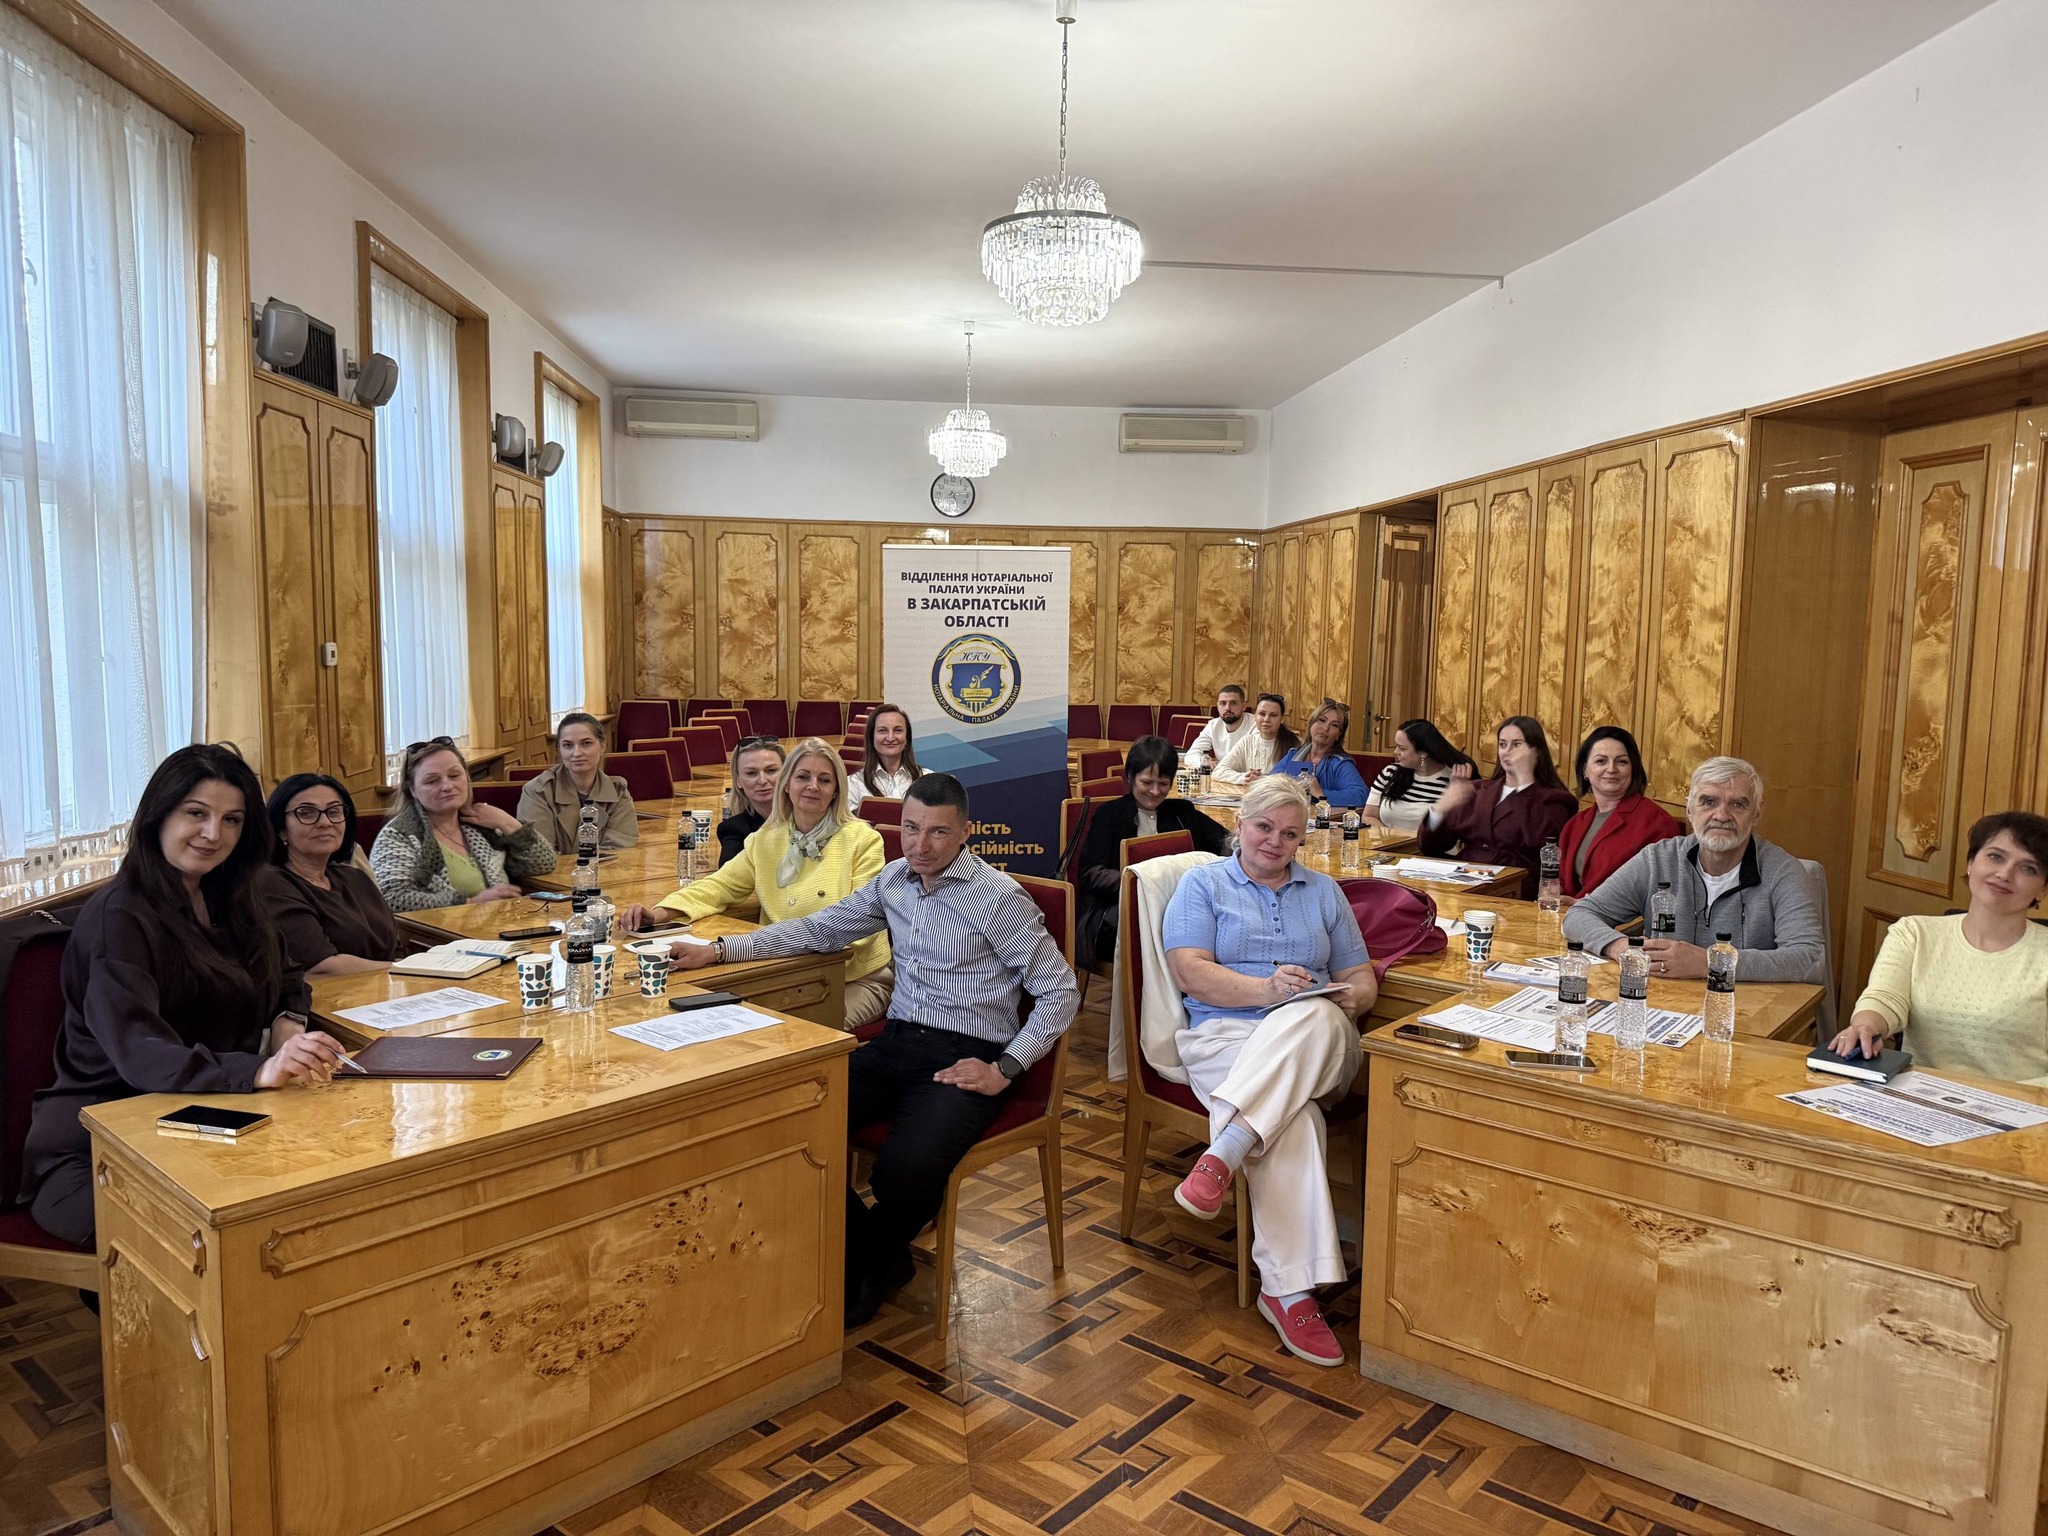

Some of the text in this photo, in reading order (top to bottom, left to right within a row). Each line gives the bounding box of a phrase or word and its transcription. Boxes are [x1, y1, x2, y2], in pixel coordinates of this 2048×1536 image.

[901, 572, 1053, 583] ВІДДІЛЕННЯ НОТАРІАЛЬНОЇ
[929, 584, 1024, 594] ПАЛАТИ УКРАЇНИ
[907, 596, 1046, 611] В ЗАКАРПАТСЬКІЙ
[944, 616, 1009, 628] ОБЛАСТІ
[934, 684, 1019, 723] НОТАРІАЛЬНА ПАЛАТА УКРАЇНИ
[970, 840, 1045, 855] сійність
